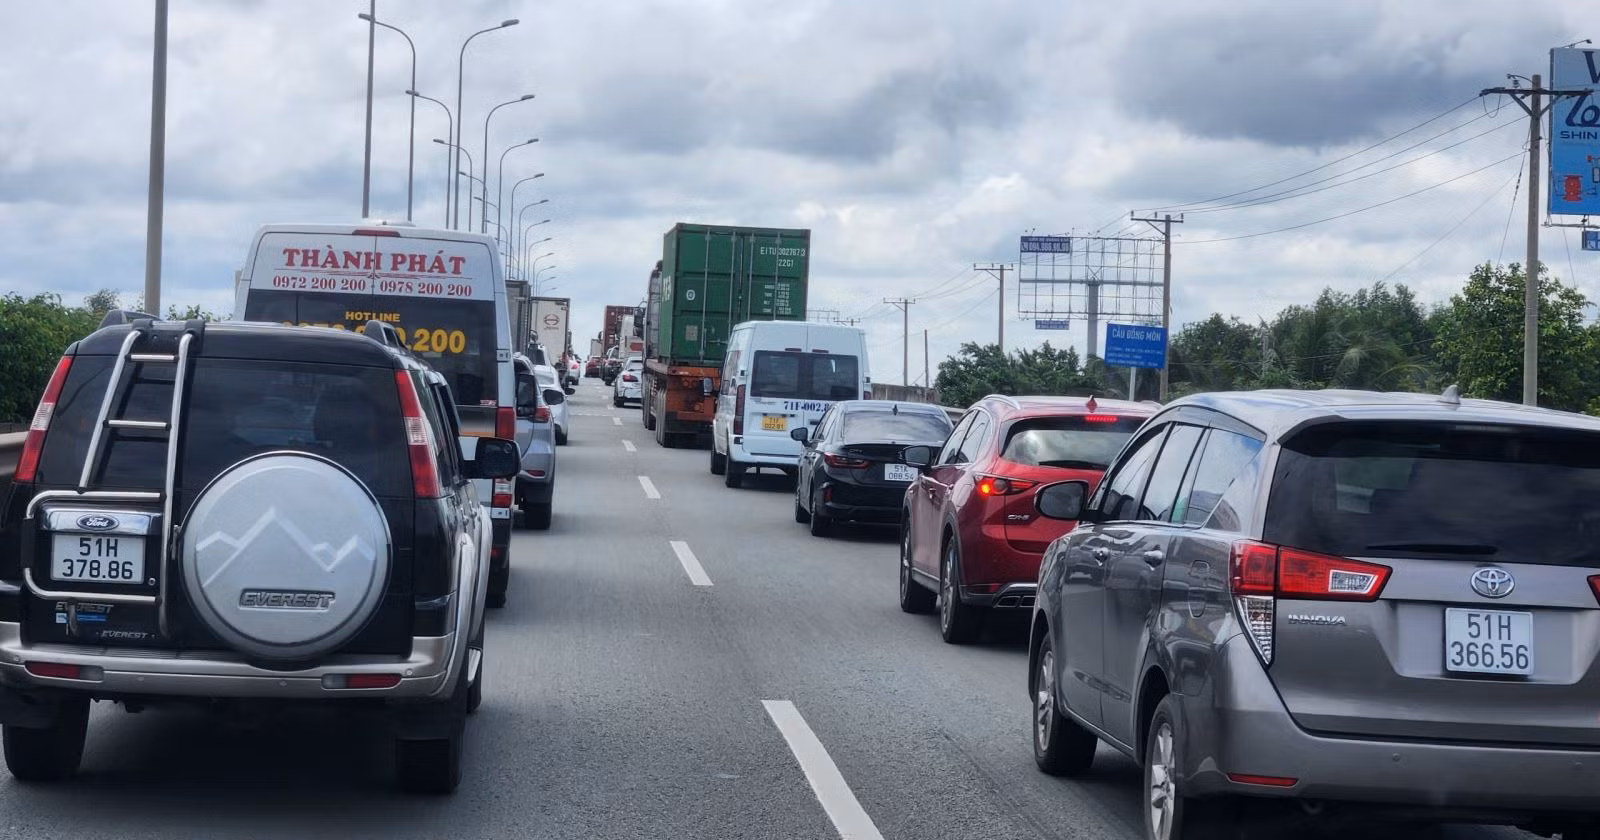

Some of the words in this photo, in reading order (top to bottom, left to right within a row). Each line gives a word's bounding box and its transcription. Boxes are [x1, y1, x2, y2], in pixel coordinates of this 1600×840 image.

[1560, 131, 1597, 140] SHIN
[283, 245, 382, 271] THÀNH
[391, 250, 466, 275] PHÁT
[760, 246, 777, 255] EITU
[778, 259, 794, 268] 22G1
[273, 275, 306, 289] 0972
[311, 277, 336, 290] 200
[341, 279, 366, 292] 200
[380, 280, 413, 294] 0978
[418, 282, 443, 296] 200
[448, 284, 473, 297] 200
[894, 465, 909, 473] 51K
[79, 537, 119, 558] 51H
[62, 558, 134, 580] 378.86
[241, 591, 334, 610] EVEREST
[1288, 614, 1346, 626] INNOVA
[1467, 613, 1511, 641] 51H
[101, 630, 149, 639] EVEREST
[1451, 641, 1529, 670] 366.56
